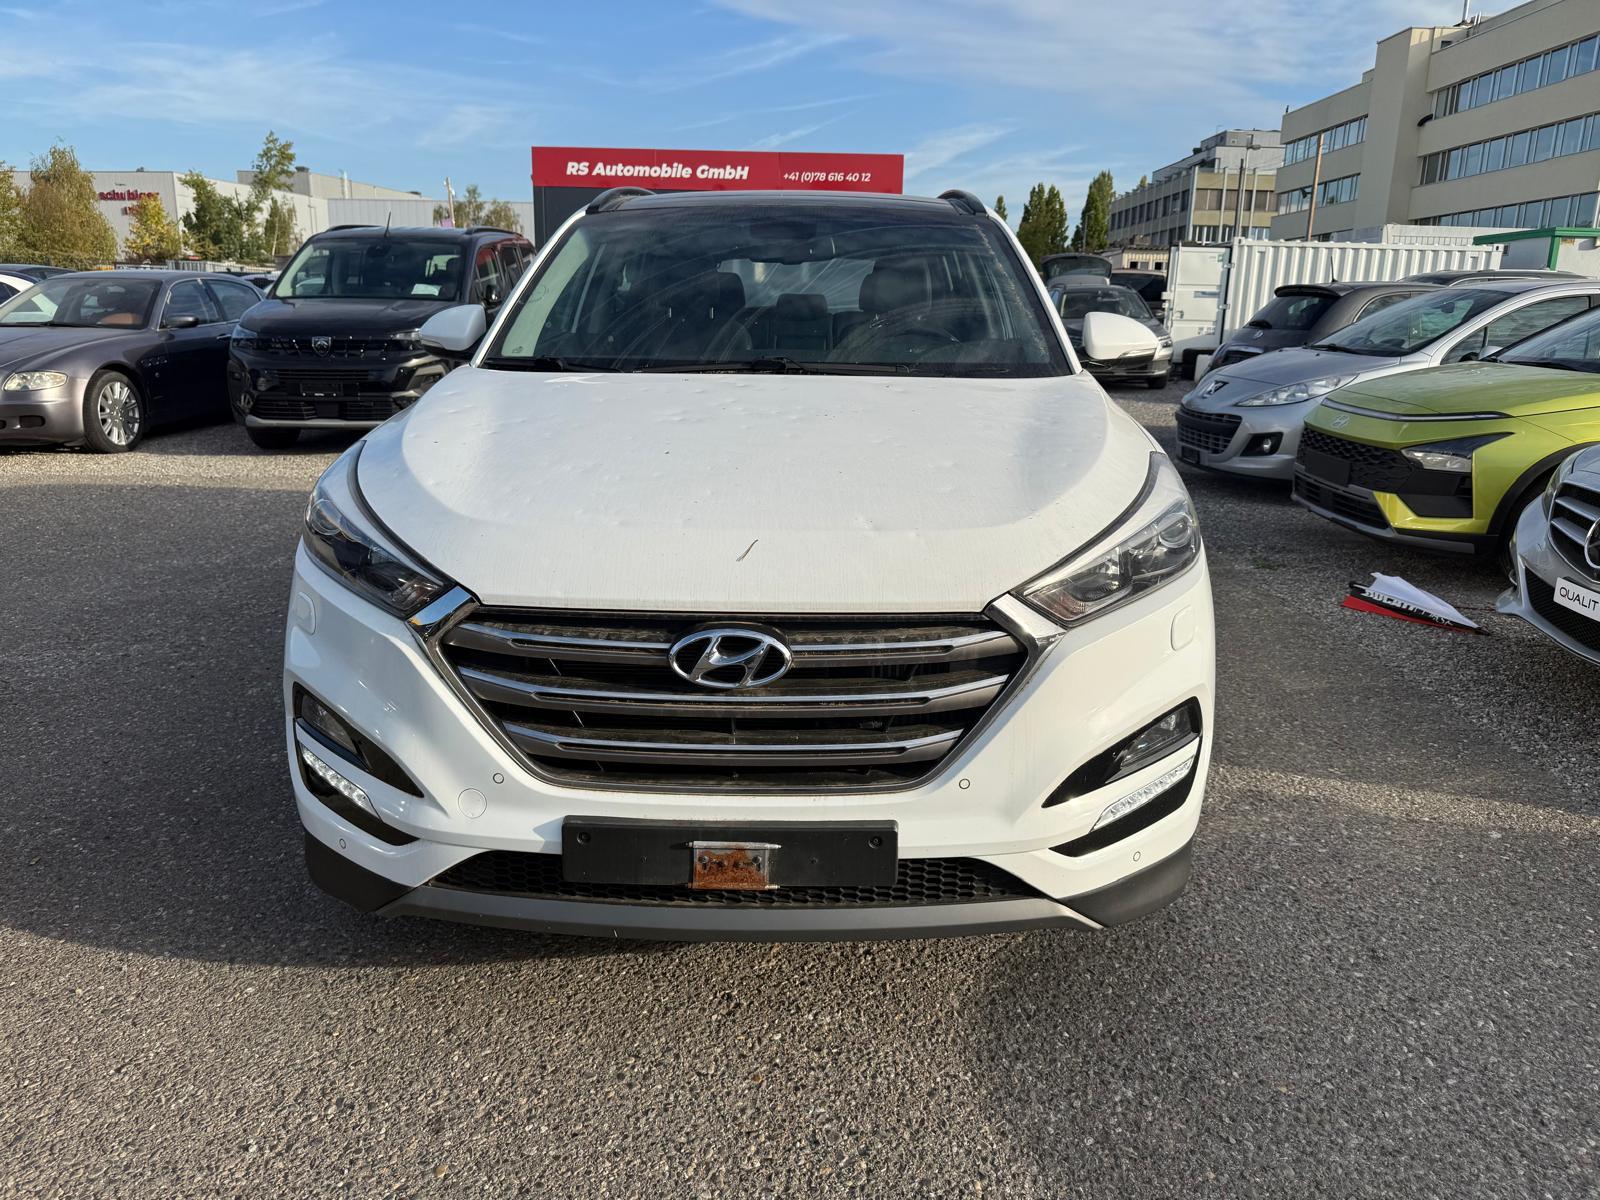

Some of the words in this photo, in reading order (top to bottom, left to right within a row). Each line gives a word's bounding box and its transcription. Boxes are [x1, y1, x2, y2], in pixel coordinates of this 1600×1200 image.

[566, 162, 589, 176] RS
[592, 162, 693, 179] Automobile
[696, 165, 750, 180] GmbH
[783, 171, 799, 181] +41
[801, 171, 827, 183] (0)78
[827, 172, 844, 182] 616
[846, 172, 859, 182] 40
[861, 173, 872, 182] 12
